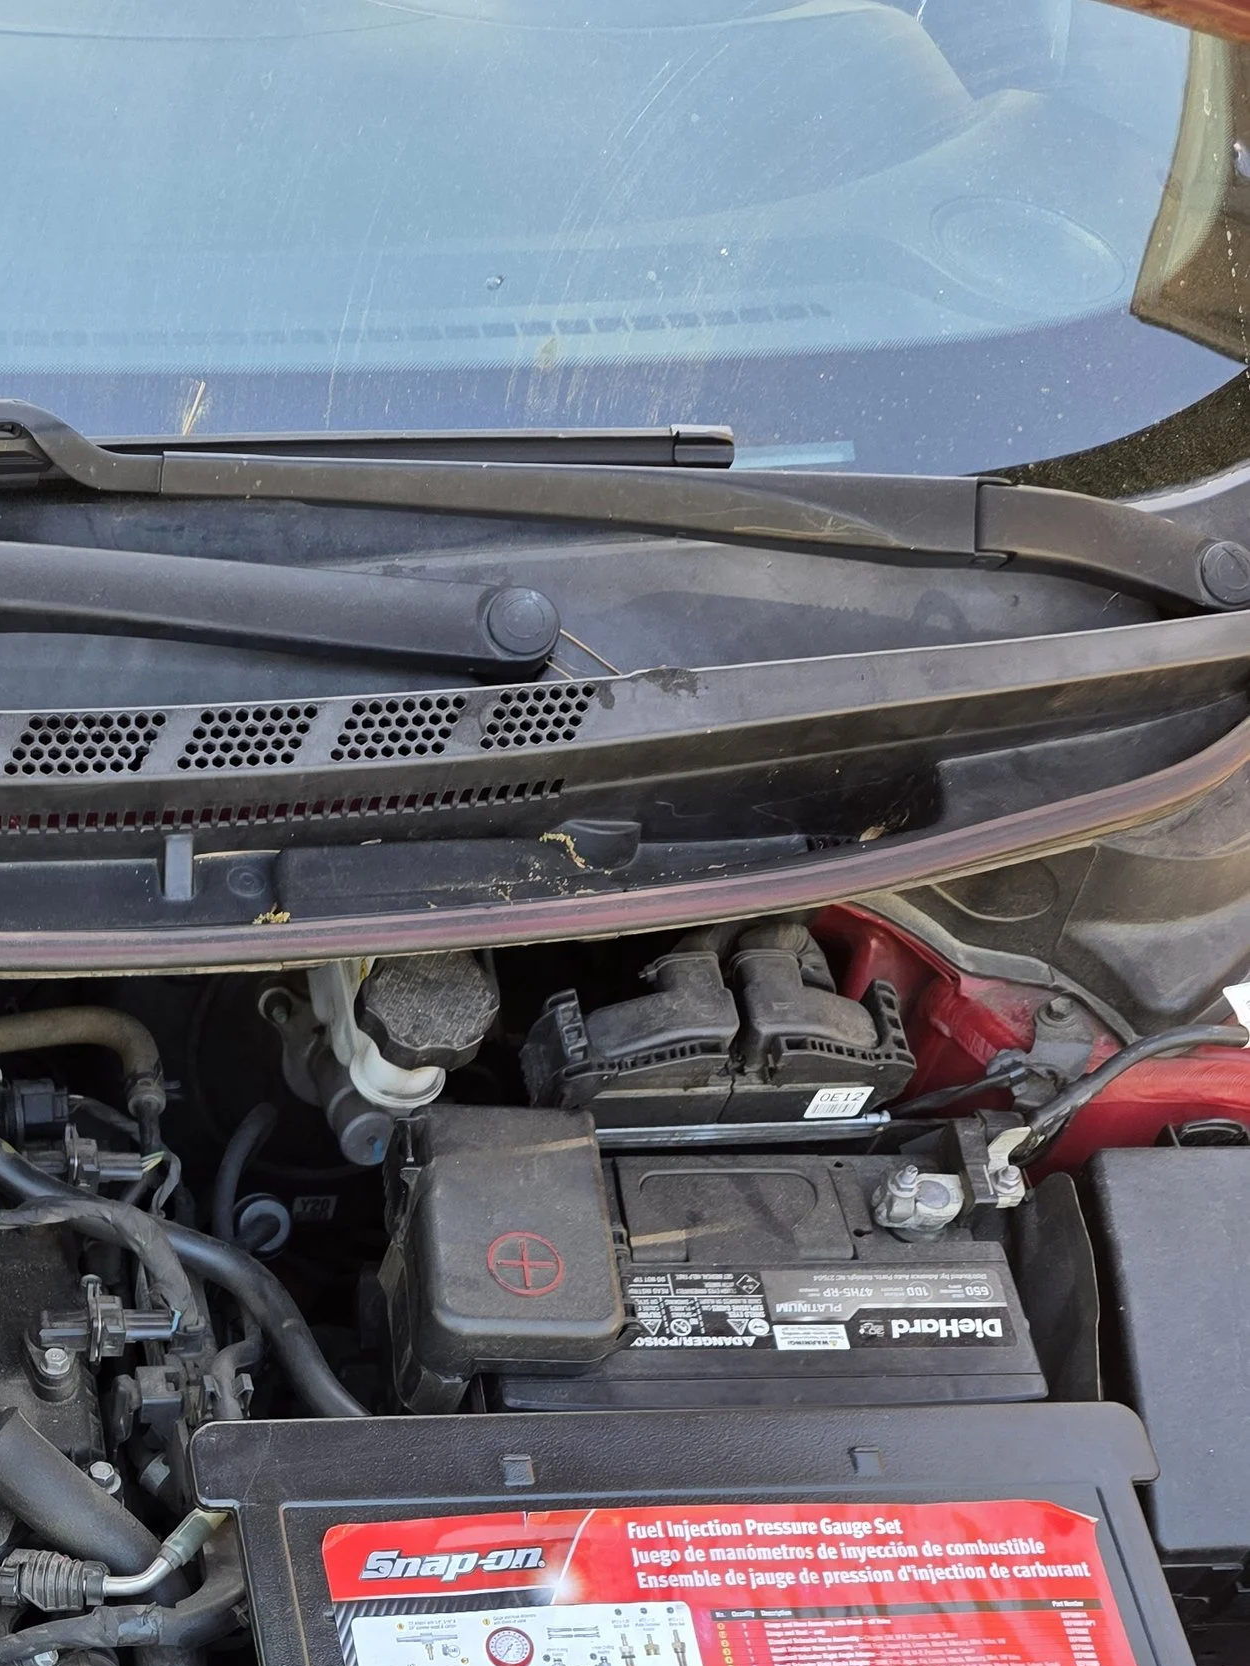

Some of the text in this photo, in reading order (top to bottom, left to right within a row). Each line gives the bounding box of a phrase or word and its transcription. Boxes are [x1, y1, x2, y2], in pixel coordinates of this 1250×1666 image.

[823, 1287, 872, 1297] 47H5-RP
[907, 1287, 928, 1296] 100
[965, 1286, 989, 1296] 650
[776, 1303, 842, 1313] PLATINUM
[890, 1318, 1003, 1338] DieHard
[627, 1517, 903, 1543] Fuel Injection Pressure Gauge Set
[630, 1536, 1046, 1572] Juego de manómetros de inyección de combustible
[360, 1548, 543, 1582] Snap-on
[636, 1561, 1092, 1591] Ensemble de jauge de pression d'injection de carburant
